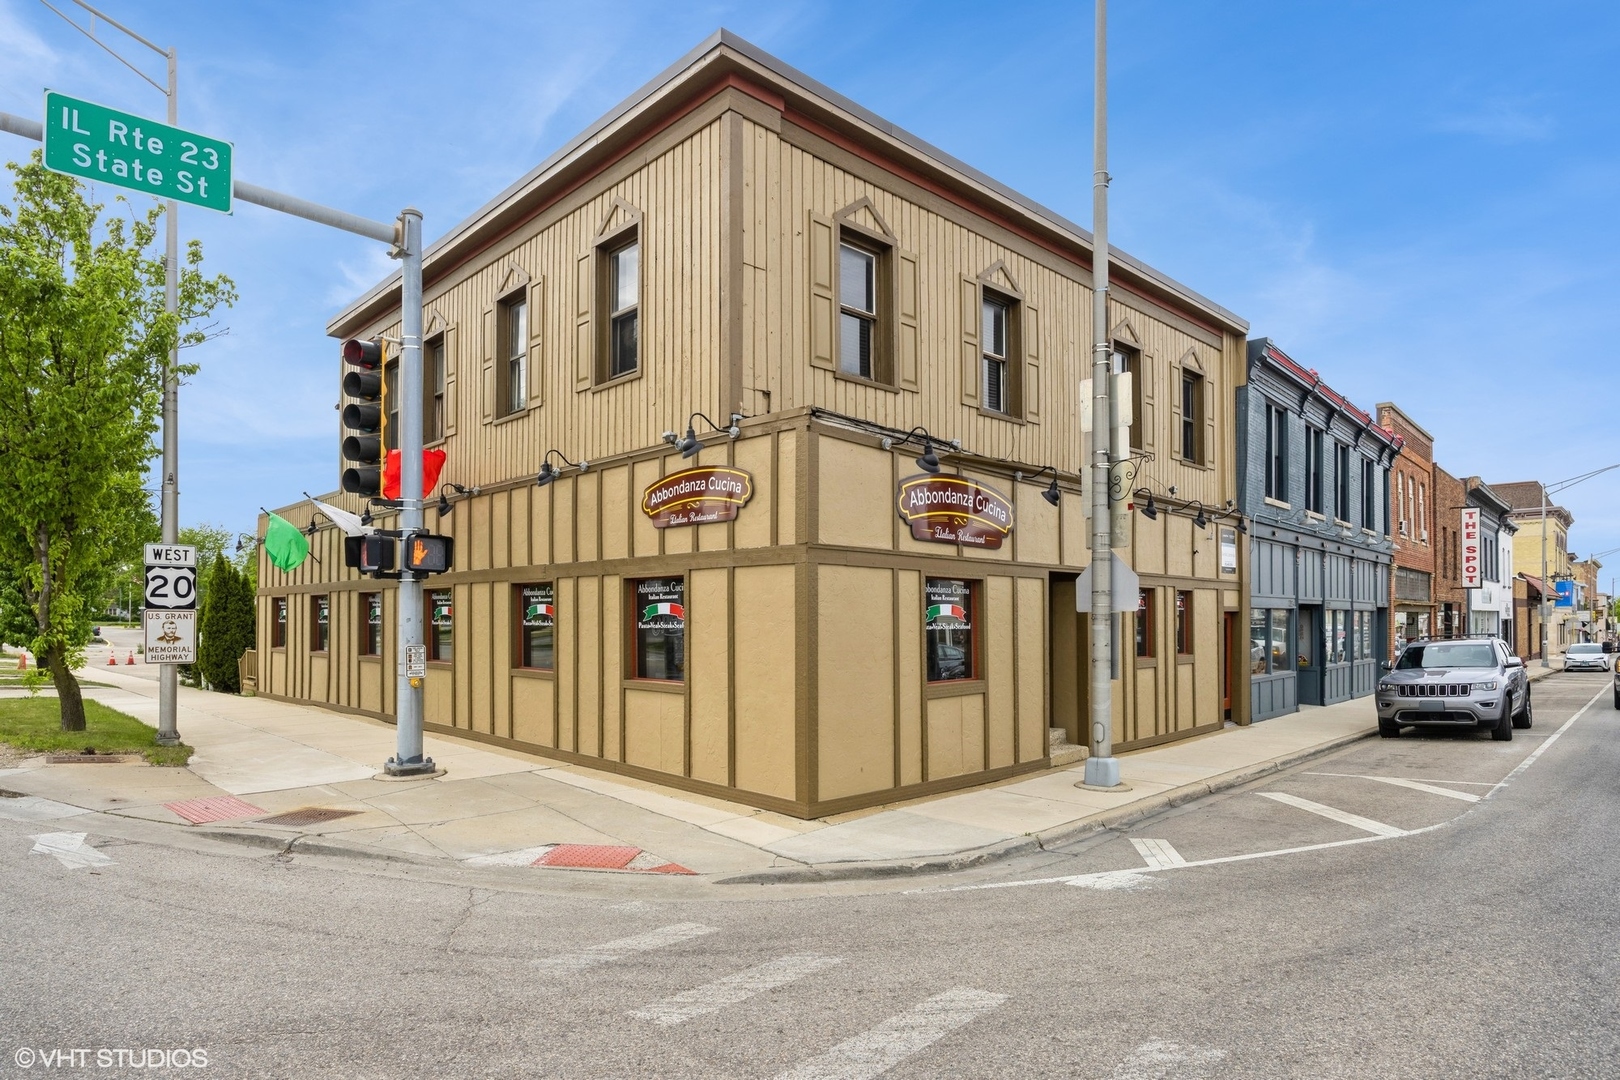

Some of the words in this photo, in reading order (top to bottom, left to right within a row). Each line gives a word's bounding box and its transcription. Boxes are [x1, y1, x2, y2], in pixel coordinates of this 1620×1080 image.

[62, 106, 91, 136] IL
[108, 119, 164, 155] Rte
[180, 141, 219, 170] 23
[72, 142, 164, 186] State
[176, 170, 208, 198] St
[650, 479, 706, 507] Abbondanza
[708, 476, 742, 494] Cucina
[910, 487, 974, 508] Abbondanza
[975, 495, 1006, 523] Cucina
[934, 525, 956, 540] Italian
[957, 528, 986, 544] Restaurant
[1465, 511, 1476, 540] THE
[153, 548, 190, 561] WEST
[1465, 545, 1477, 583] SPOT
[149, 574, 192, 599] 20
[151, 653, 189, 661] HIGHWAY
